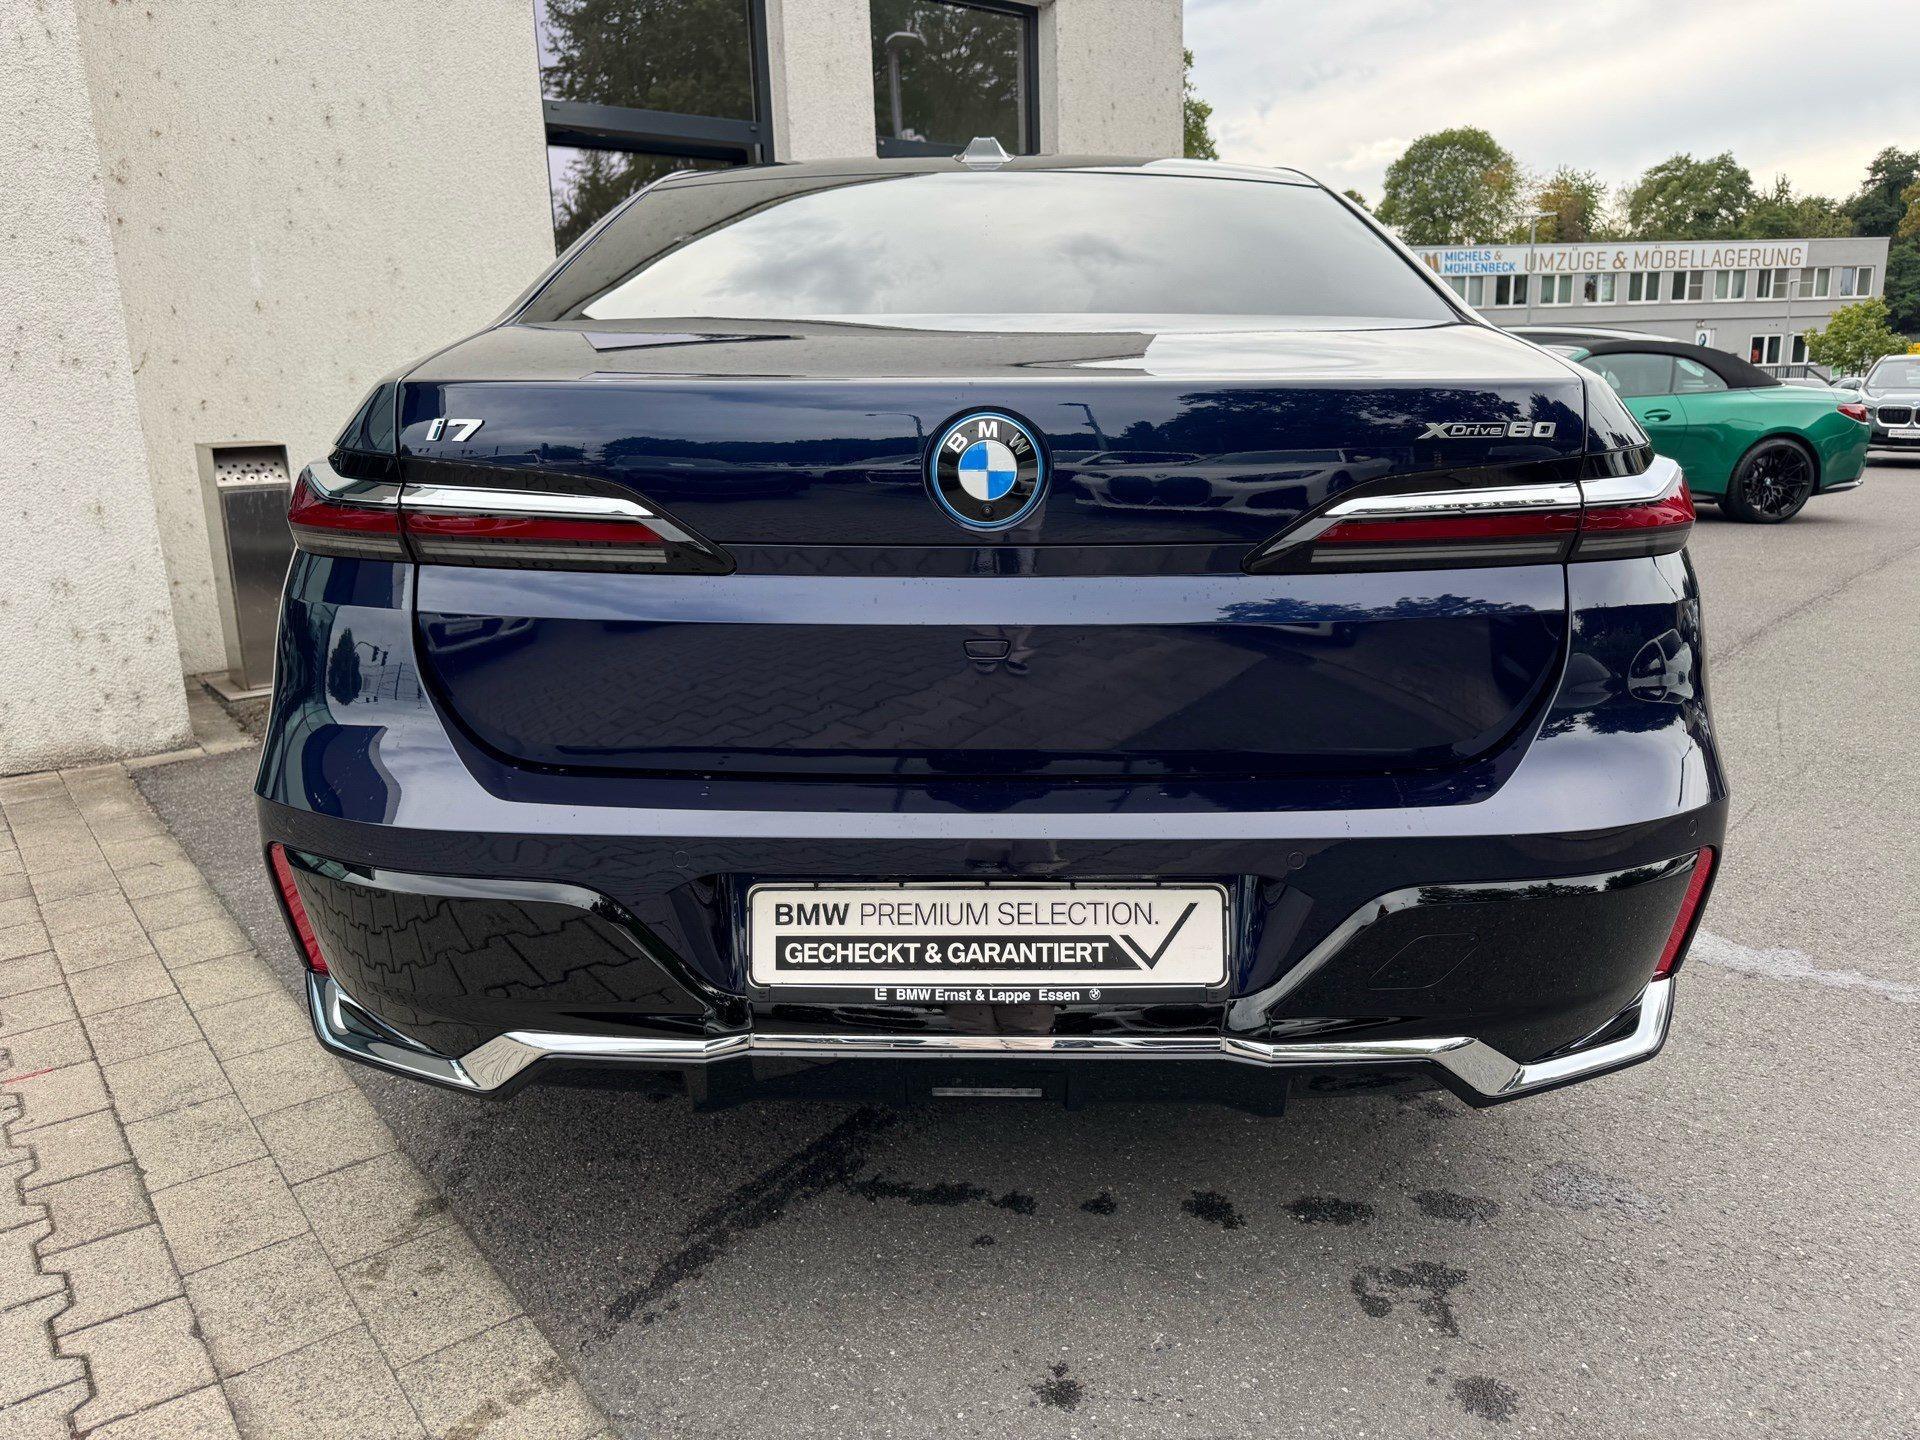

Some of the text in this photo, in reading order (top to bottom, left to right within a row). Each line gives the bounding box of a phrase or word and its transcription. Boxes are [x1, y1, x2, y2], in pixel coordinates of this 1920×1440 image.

[1444, 250, 1503, 261] MICHELS &
[1524, 244, 1802, 272] UMZÜGE & MÖBELLAGERUNG
[426, 418, 484, 442] i7
[946, 421, 1030, 455] BMW
[775, 902, 1160, 926] BMW PREMIUM SELECTION.
[784, 942, 1109, 964] GECHECKT & GARANTIERT
[896, 989, 931, 1001] BMW
[935, 989, 971, 1001] Ernst
[974, 989, 985, 1001] &
[989, 989, 1031, 1004] Lappe
[1038, 989, 1080, 1001] Essen
